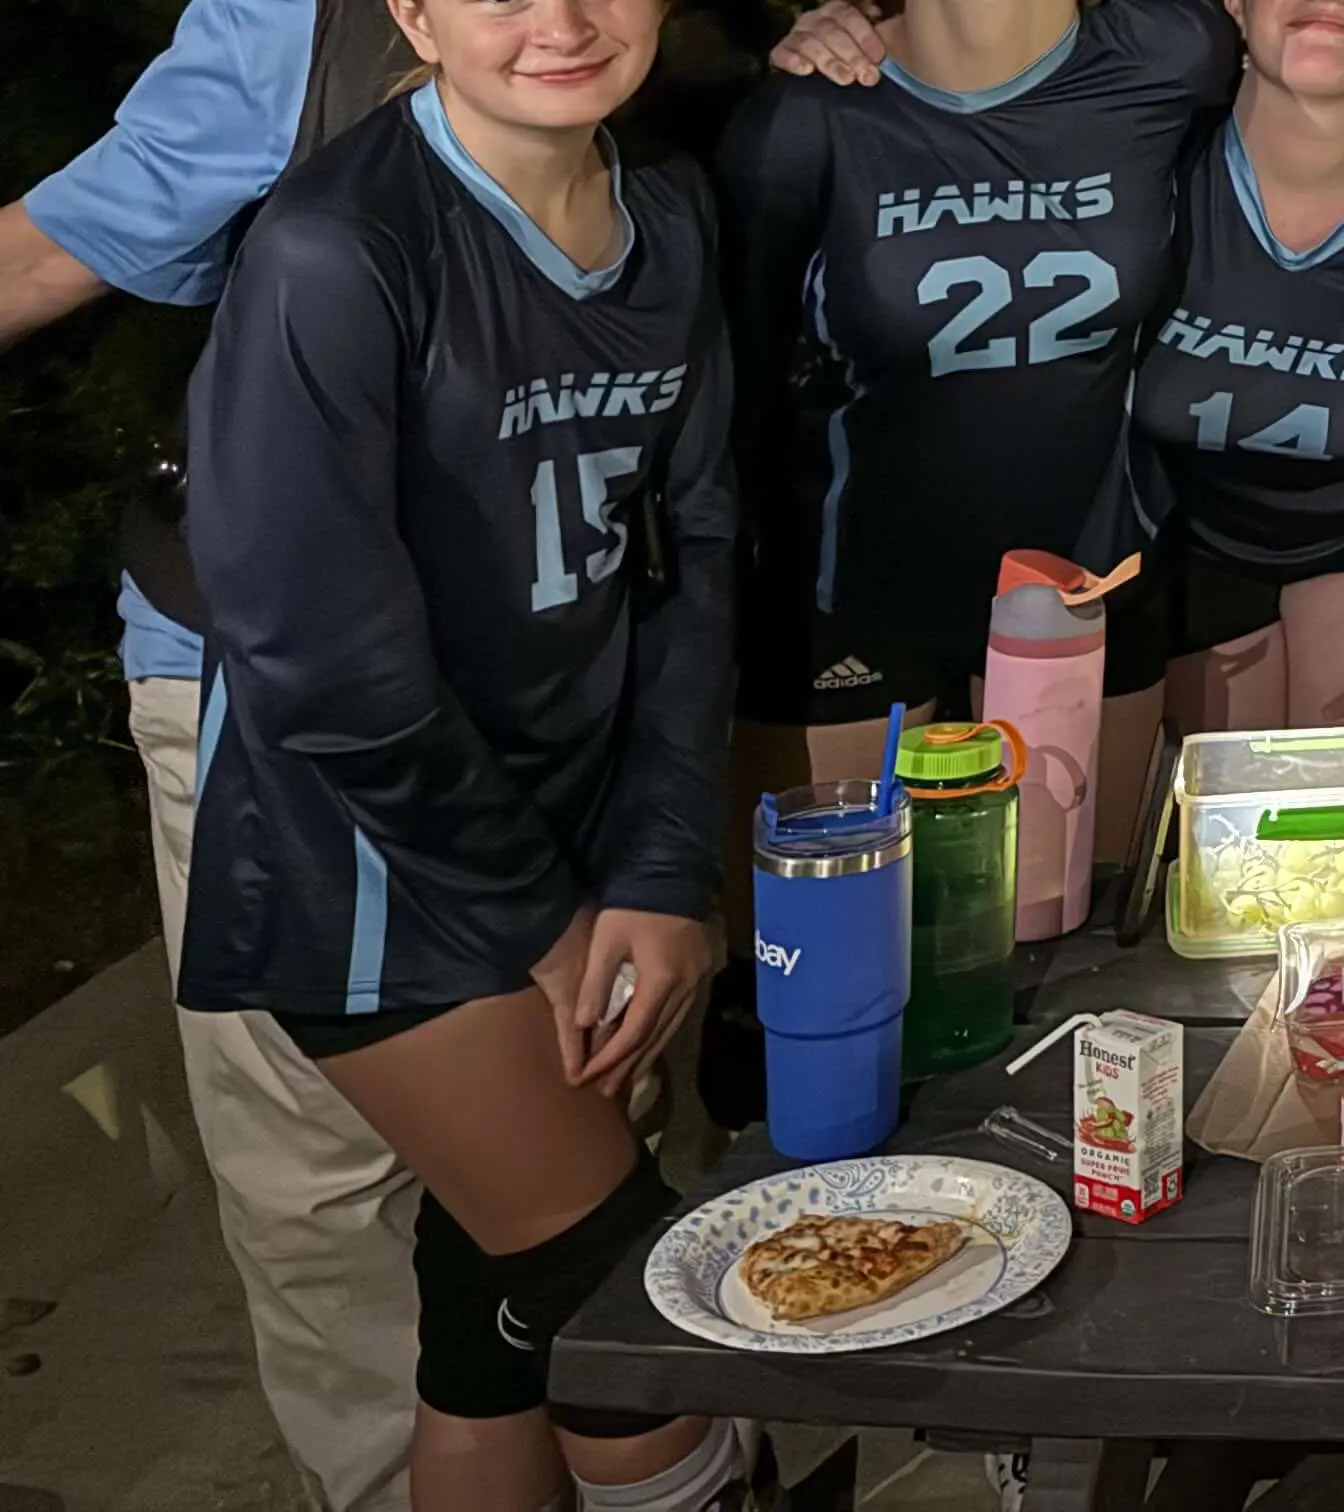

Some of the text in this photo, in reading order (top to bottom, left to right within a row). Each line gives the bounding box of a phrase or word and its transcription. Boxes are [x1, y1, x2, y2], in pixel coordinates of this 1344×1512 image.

[877, 172, 1115, 238] HAWKS
[916, 249, 1120, 378] 22
[497, 363, 689, 440] HAWKS
[1188, 390, 1334, 461] 14
[529, 445, 643, 614] 15
[813, 672, 883, 690] adidas
[754, 928, 802, 976] bay
[1080, 1039, 1136, 1071] Honest
[1080, 1146, 1130, 1166] ORGANIC
